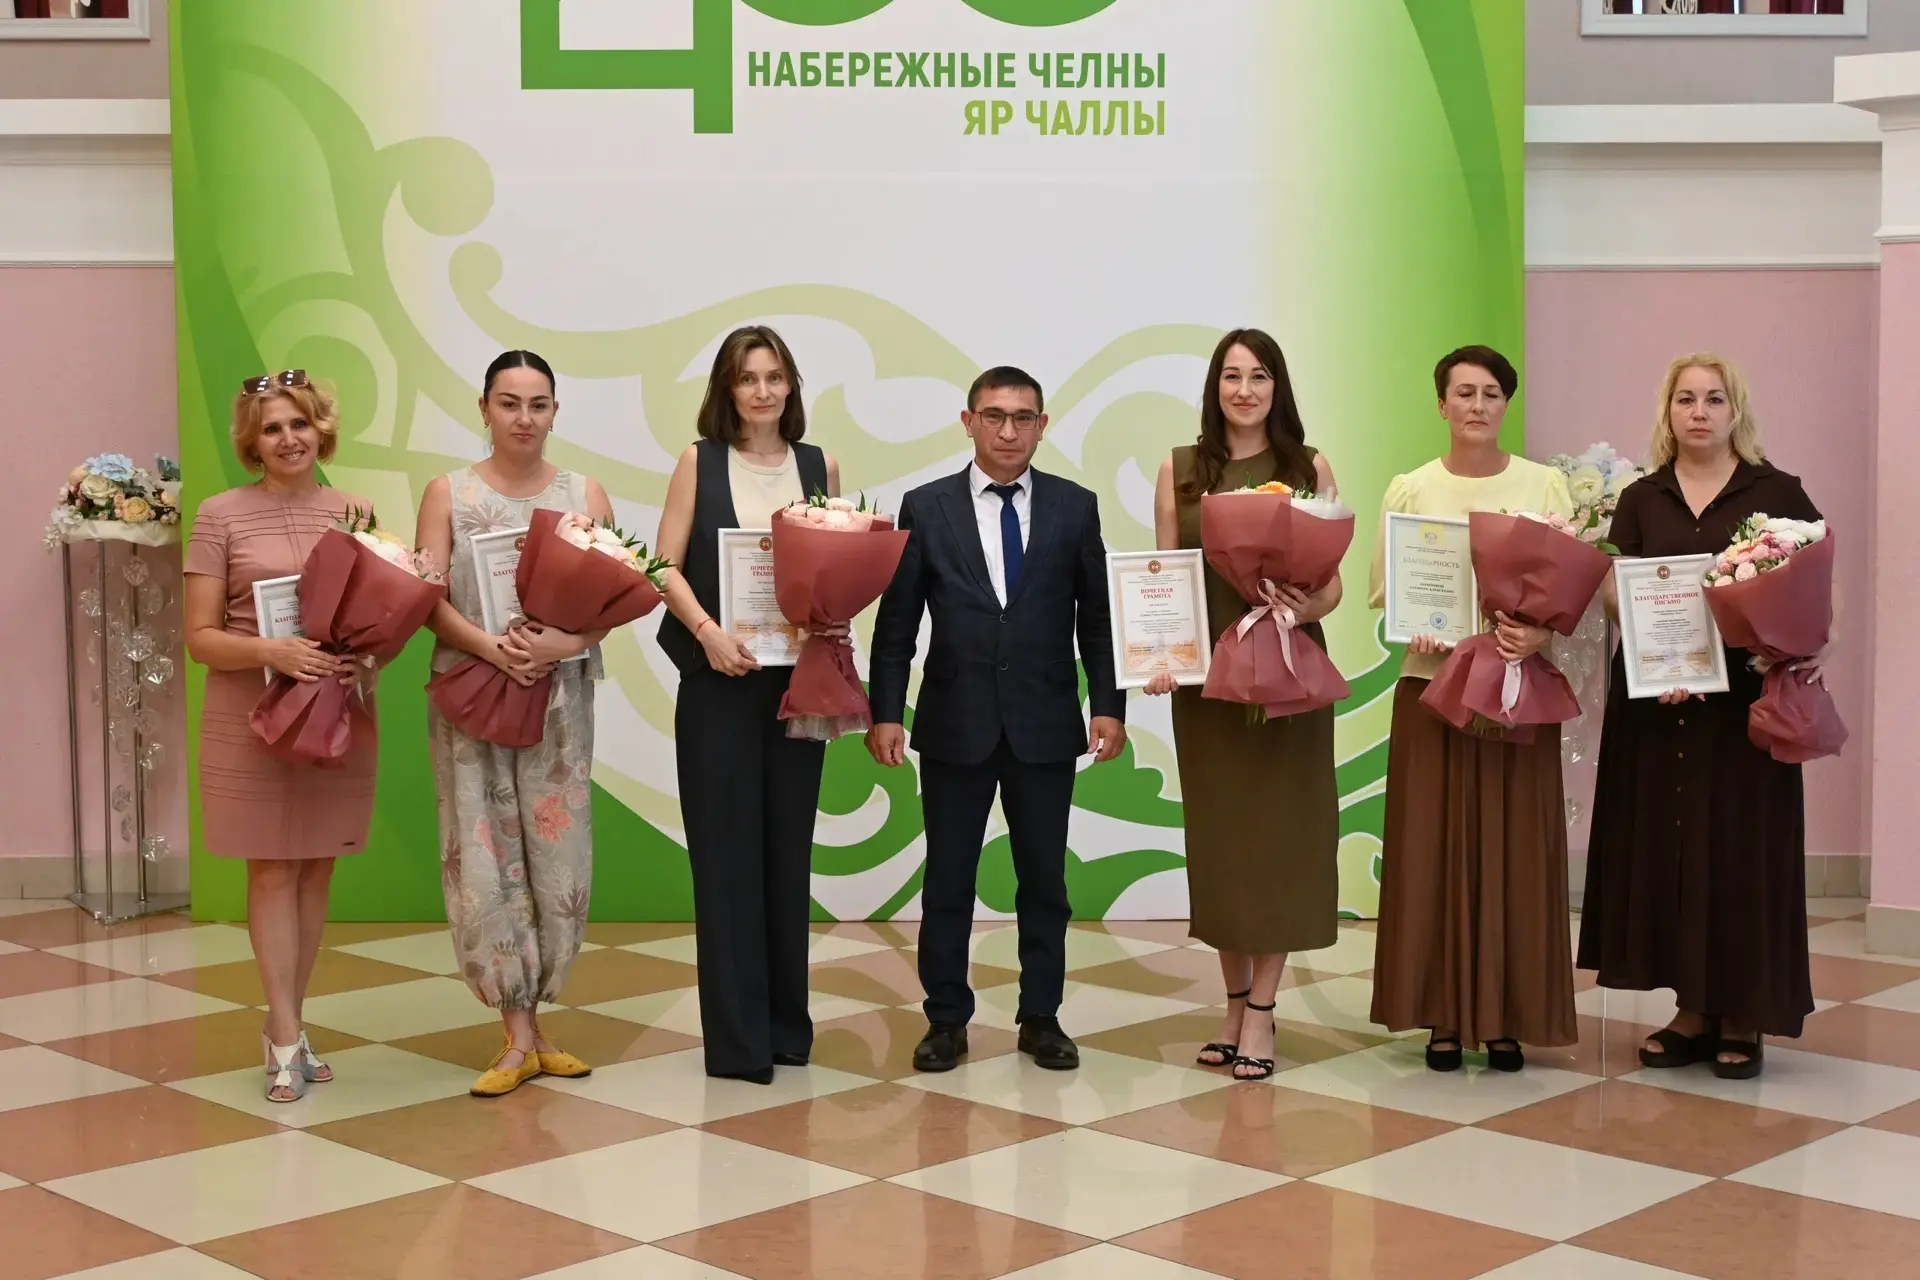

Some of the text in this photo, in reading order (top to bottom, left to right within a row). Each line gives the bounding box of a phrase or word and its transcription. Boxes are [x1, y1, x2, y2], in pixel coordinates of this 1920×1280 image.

[748, 51, 1166, 89] НАБЕРЕЖНЫЕ ЧЕЛНЫ
[963, 100, 1166, 136] ЯР ЧАЛЛЫ
[1634, 591, 1700, 602] БЛАГОДАРСТВЕННОЕ
